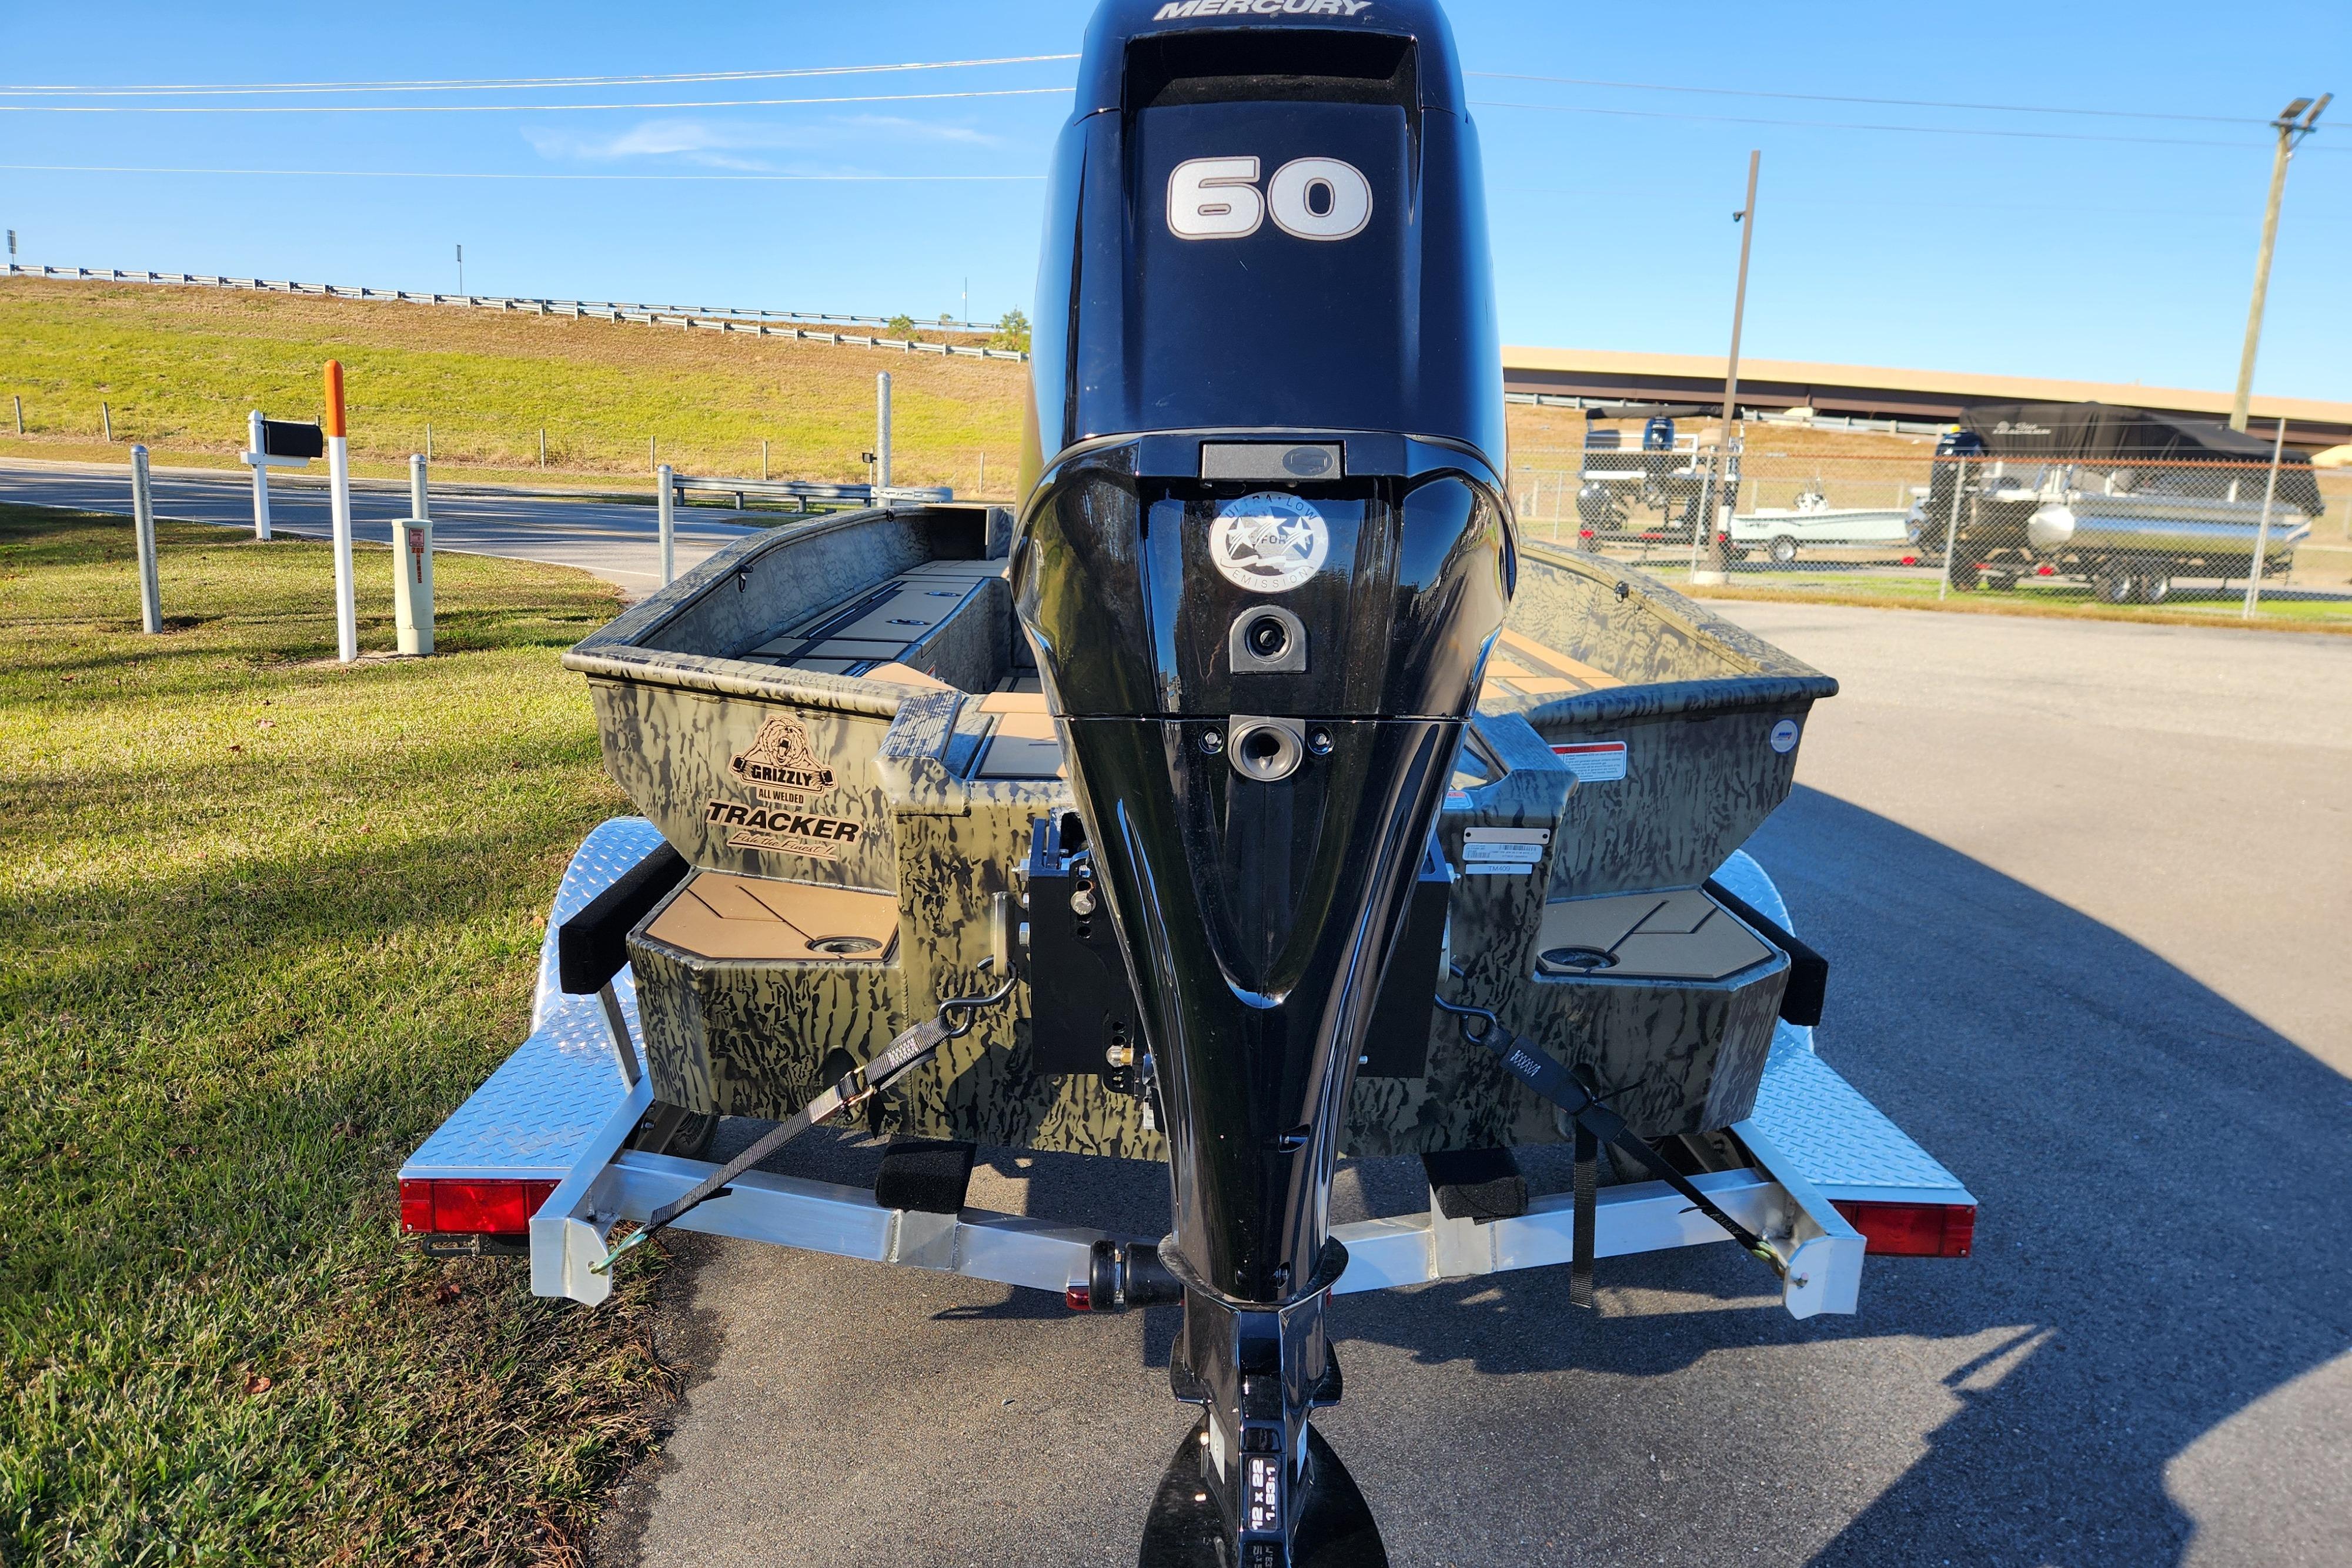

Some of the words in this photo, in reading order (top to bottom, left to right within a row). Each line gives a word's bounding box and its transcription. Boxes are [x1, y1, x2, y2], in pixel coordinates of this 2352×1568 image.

[1153, 0, 1372, 19] MERCURY
[1167, 155, 1372, 241] 60
[1232, 569, 1308, 588] EMISSION
[751, 765, 811, 787] GRIZZLY
[759, 789, 771, 798] ALL
[773, 790, 804, 804] WELDED
[710, 802, 860, 842] TRACKER
[733, 833, 759, 843] Fish
[761, 835, 779, 847] the
[1252, 1459, 1264, 1487] 22
[1265, 1466, 1277, 1521] 1.83:1
[1252, 1507, 1264, 1530] 12
